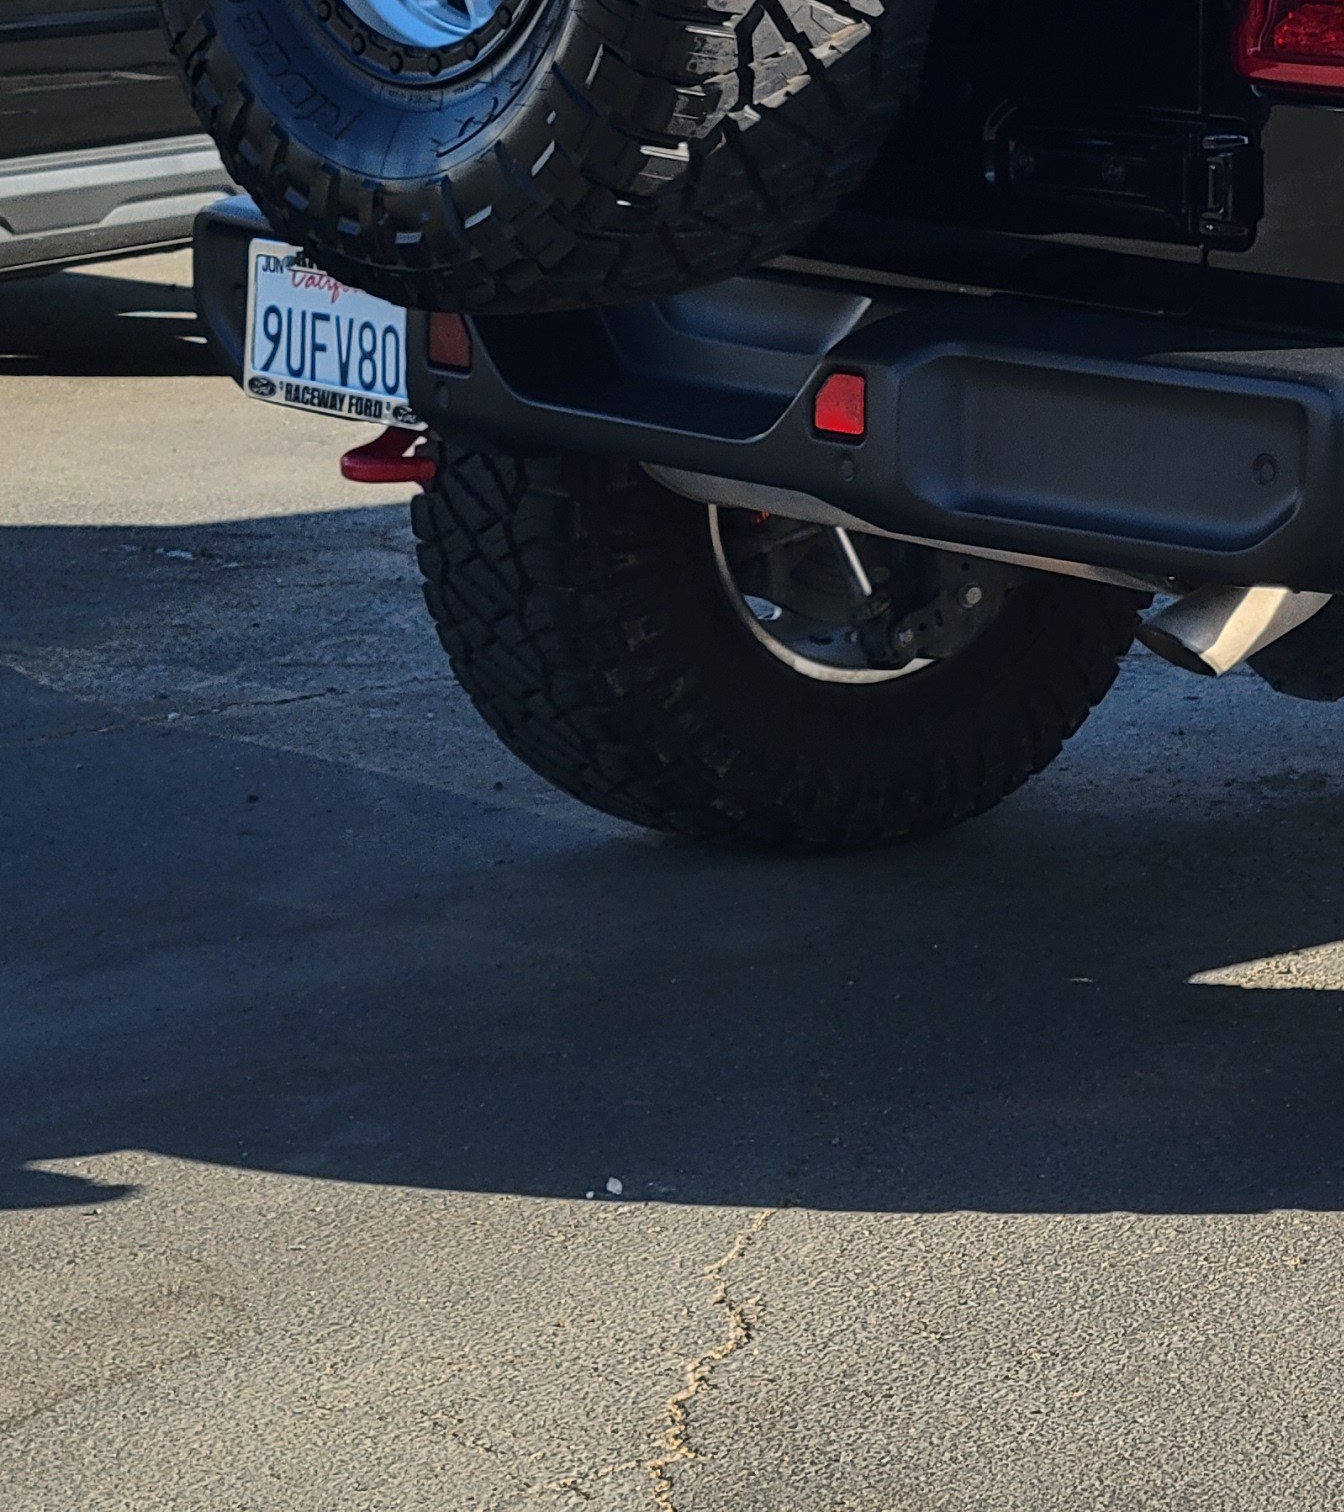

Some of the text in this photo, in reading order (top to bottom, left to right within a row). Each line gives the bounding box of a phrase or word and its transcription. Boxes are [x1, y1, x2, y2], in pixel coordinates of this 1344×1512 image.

[261, 255, 284, 274] JUN
[260, 305, 401, 396] 9UFV80
[284, 382, 346, 412] RACEWAY
[347, 394, 383, 419] FORD
